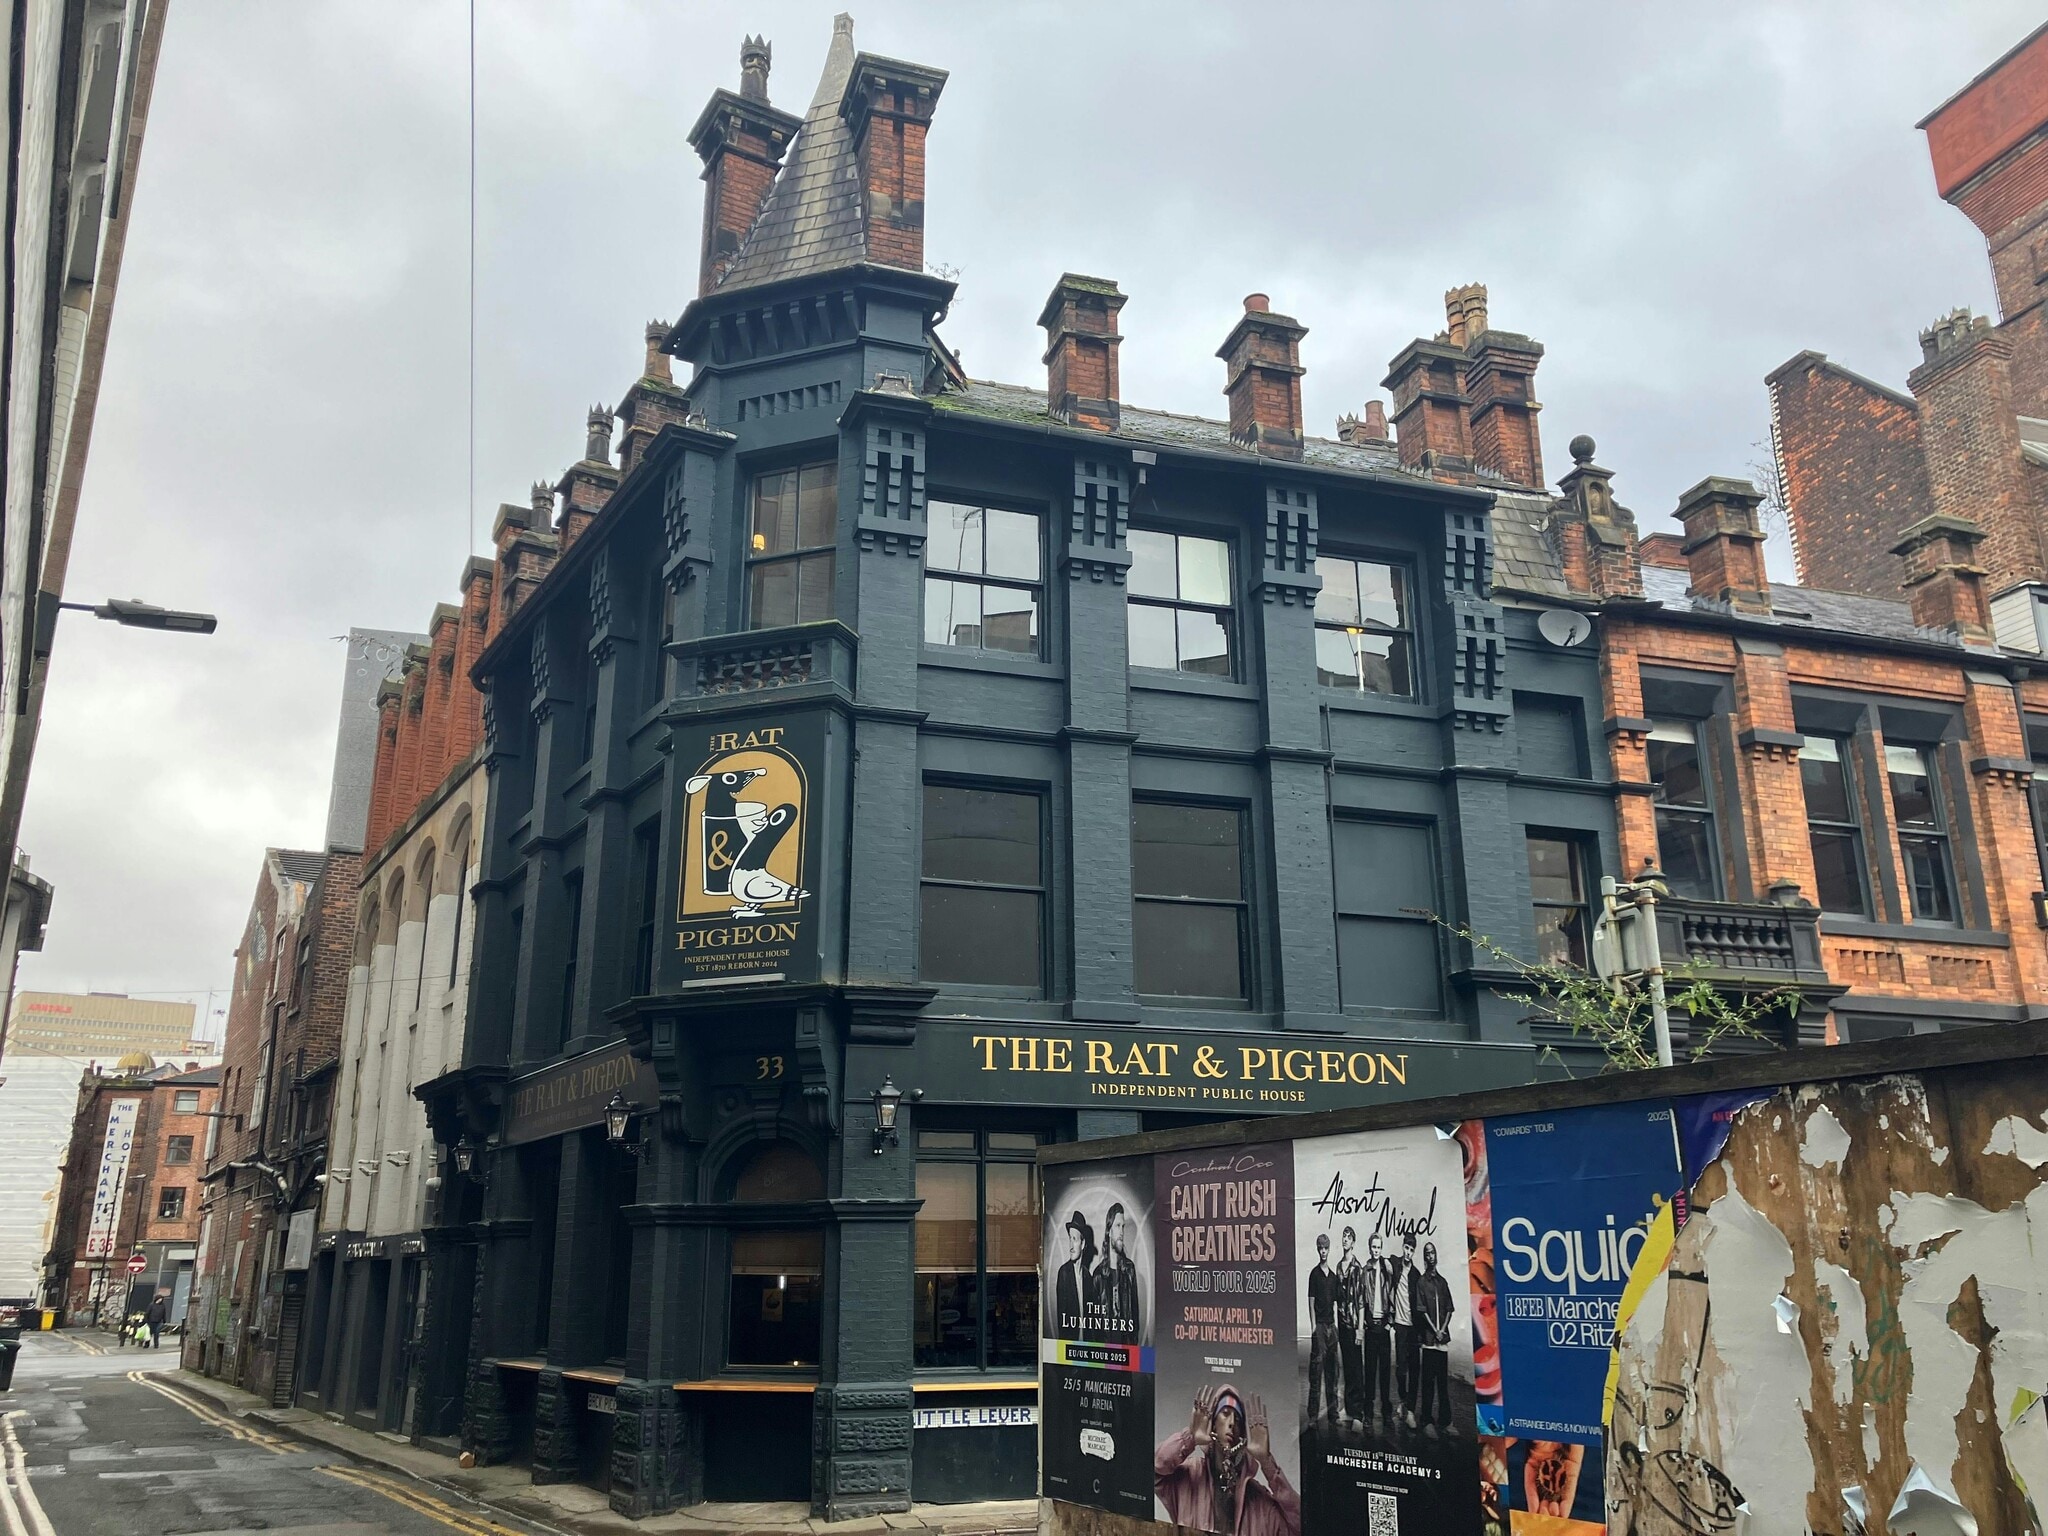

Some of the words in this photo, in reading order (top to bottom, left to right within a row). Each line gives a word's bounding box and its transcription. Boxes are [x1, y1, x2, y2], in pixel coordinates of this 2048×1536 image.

[715, 727, 784, 751] RAT
[708, 830, 734, 871] &
[675, 921, 801, 950] PIGEON
[684, 953, 737, 964] INDEPENDENT
[738, 951, 764, 960] PUBLIC
[765, 949, 790, 957] HOUSE
[695, 964, 710, 972] EST
[728, 961, 760, 970] REBORN
[756, 1056, 784, 1080] 33
[972, 1036, 1073, 1073] THE
[1084, 1040, 1178, 1077] RAT
[1192, 1045, 1229, 1079] &
[1238, 1047, 1409, 1086] PIGEON
[536, 1075, 566, 1113] RAT
[567, 1072, 577, 1102] &
[580, 1053, 637, 1099] PIGEON
[1091, 1082, 1197, 1099] INDEPENDENT
[1202, 1087, 1254, 1101] PUBLIC
[1259, 1088, 1306, 1102] HOUSE
[1647, 1111, 1670, 1122] 2025
[1534, 1123, 1554, 1133] TOUR
[94, 1116, 119, 1224] MERCHANTS
[1225, 1179, 1277, 1218] RUSH
[1171, 1223, 1276, 1262] GREATNESS
[1172, 1270, 1211, 1292] WORLD
[1213, 1270, 1244, 1293] TOUR
[1246, 1270, 1276, 1293] 2025
[1184, 1306, 1225, 1325] SATURDAY,
[1226, 1308, 1250, 1324] APRIL
[1252, 1308, 1263, 1324] 19
[1508, 1297, 1544, 1318] 18FEB
[1062, 1313, 1134, 1332] LUMINEERS
[1175, 1324, 1199, 1340] CO-OP
[1200, 1326, 1218, 1342] LIVE
[1219, 1327, 1274, 1345] MANCHESTER
[1581, 1323, 1616, 1347] Ritz
[1068, 1349, 1089, 1359] EU/UK
[1091, 1351, 1109, 1361] TOUR
[1111, 1352, 1127, 1362] 2025
[1063, 1377, 1081, 1392] 25/5
[1085, 1380, 1132, 1397] MANCHESTER
[1092, 1398, 1113, 1412] ARENA
[913, 1409, 970, 1426] ITTLE
[980, 1407, 1031, 1424] LEVER
[1515, 1419, 1545, 1430] STRANGE
[1546, 1422, 1563, 1432] DAYS
[1570, 1424, 1588, 1434] NOW
[1343, 1448, 1371, 1459] TUESDAY
[1384, 1453, 1418, 1465] FEBRUARY
[1326, 1455, 1384, 1471] MANCHESTER
[1387, 1464, 1432, 1479] ACADEMY
[1434, 1469, 1441, 1480] 3
